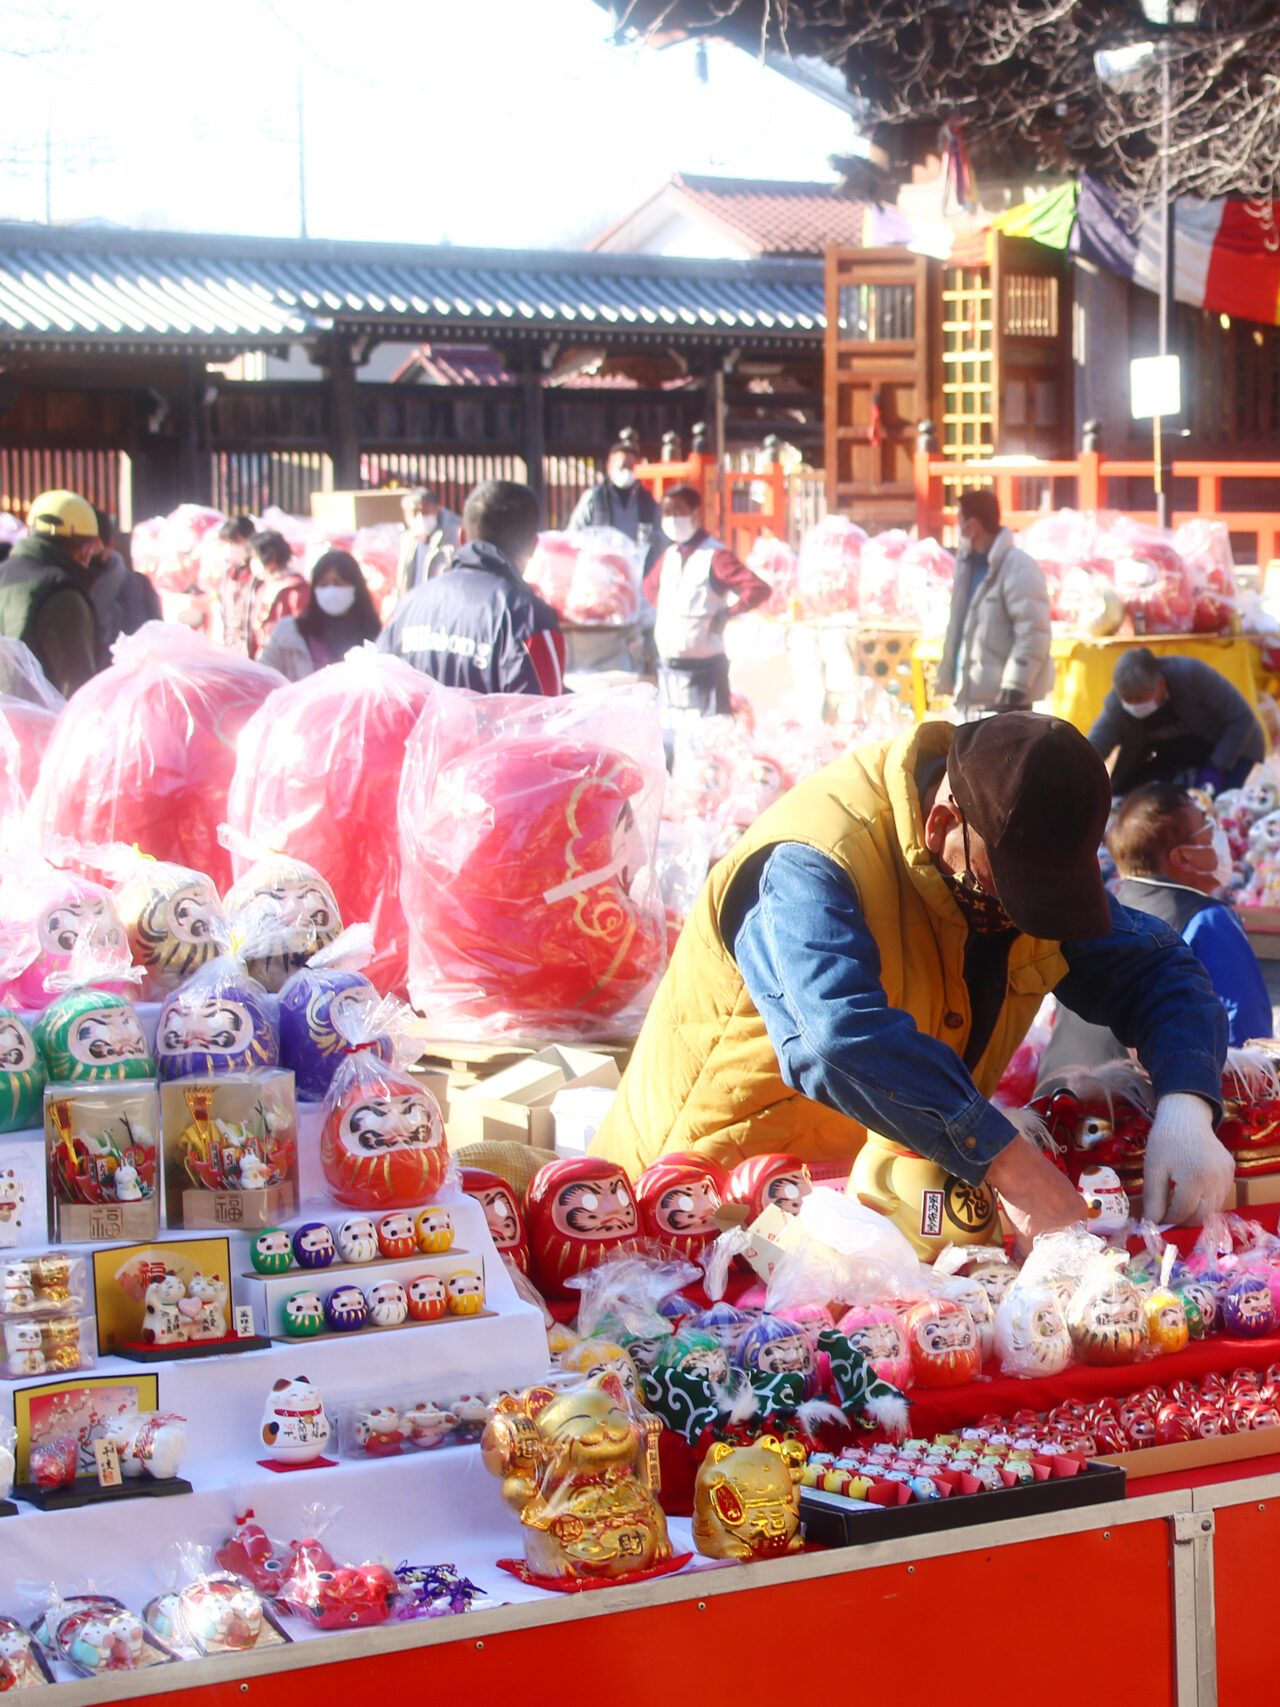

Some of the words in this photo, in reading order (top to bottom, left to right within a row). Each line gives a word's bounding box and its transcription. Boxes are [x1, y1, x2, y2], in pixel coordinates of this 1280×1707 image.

[218, 1194, 242, 1220] 福
[955, 1183, 990, 1223] 福
[91, 1208, 122, 1238] 福
[618, 1530, 645, 1557] 財
